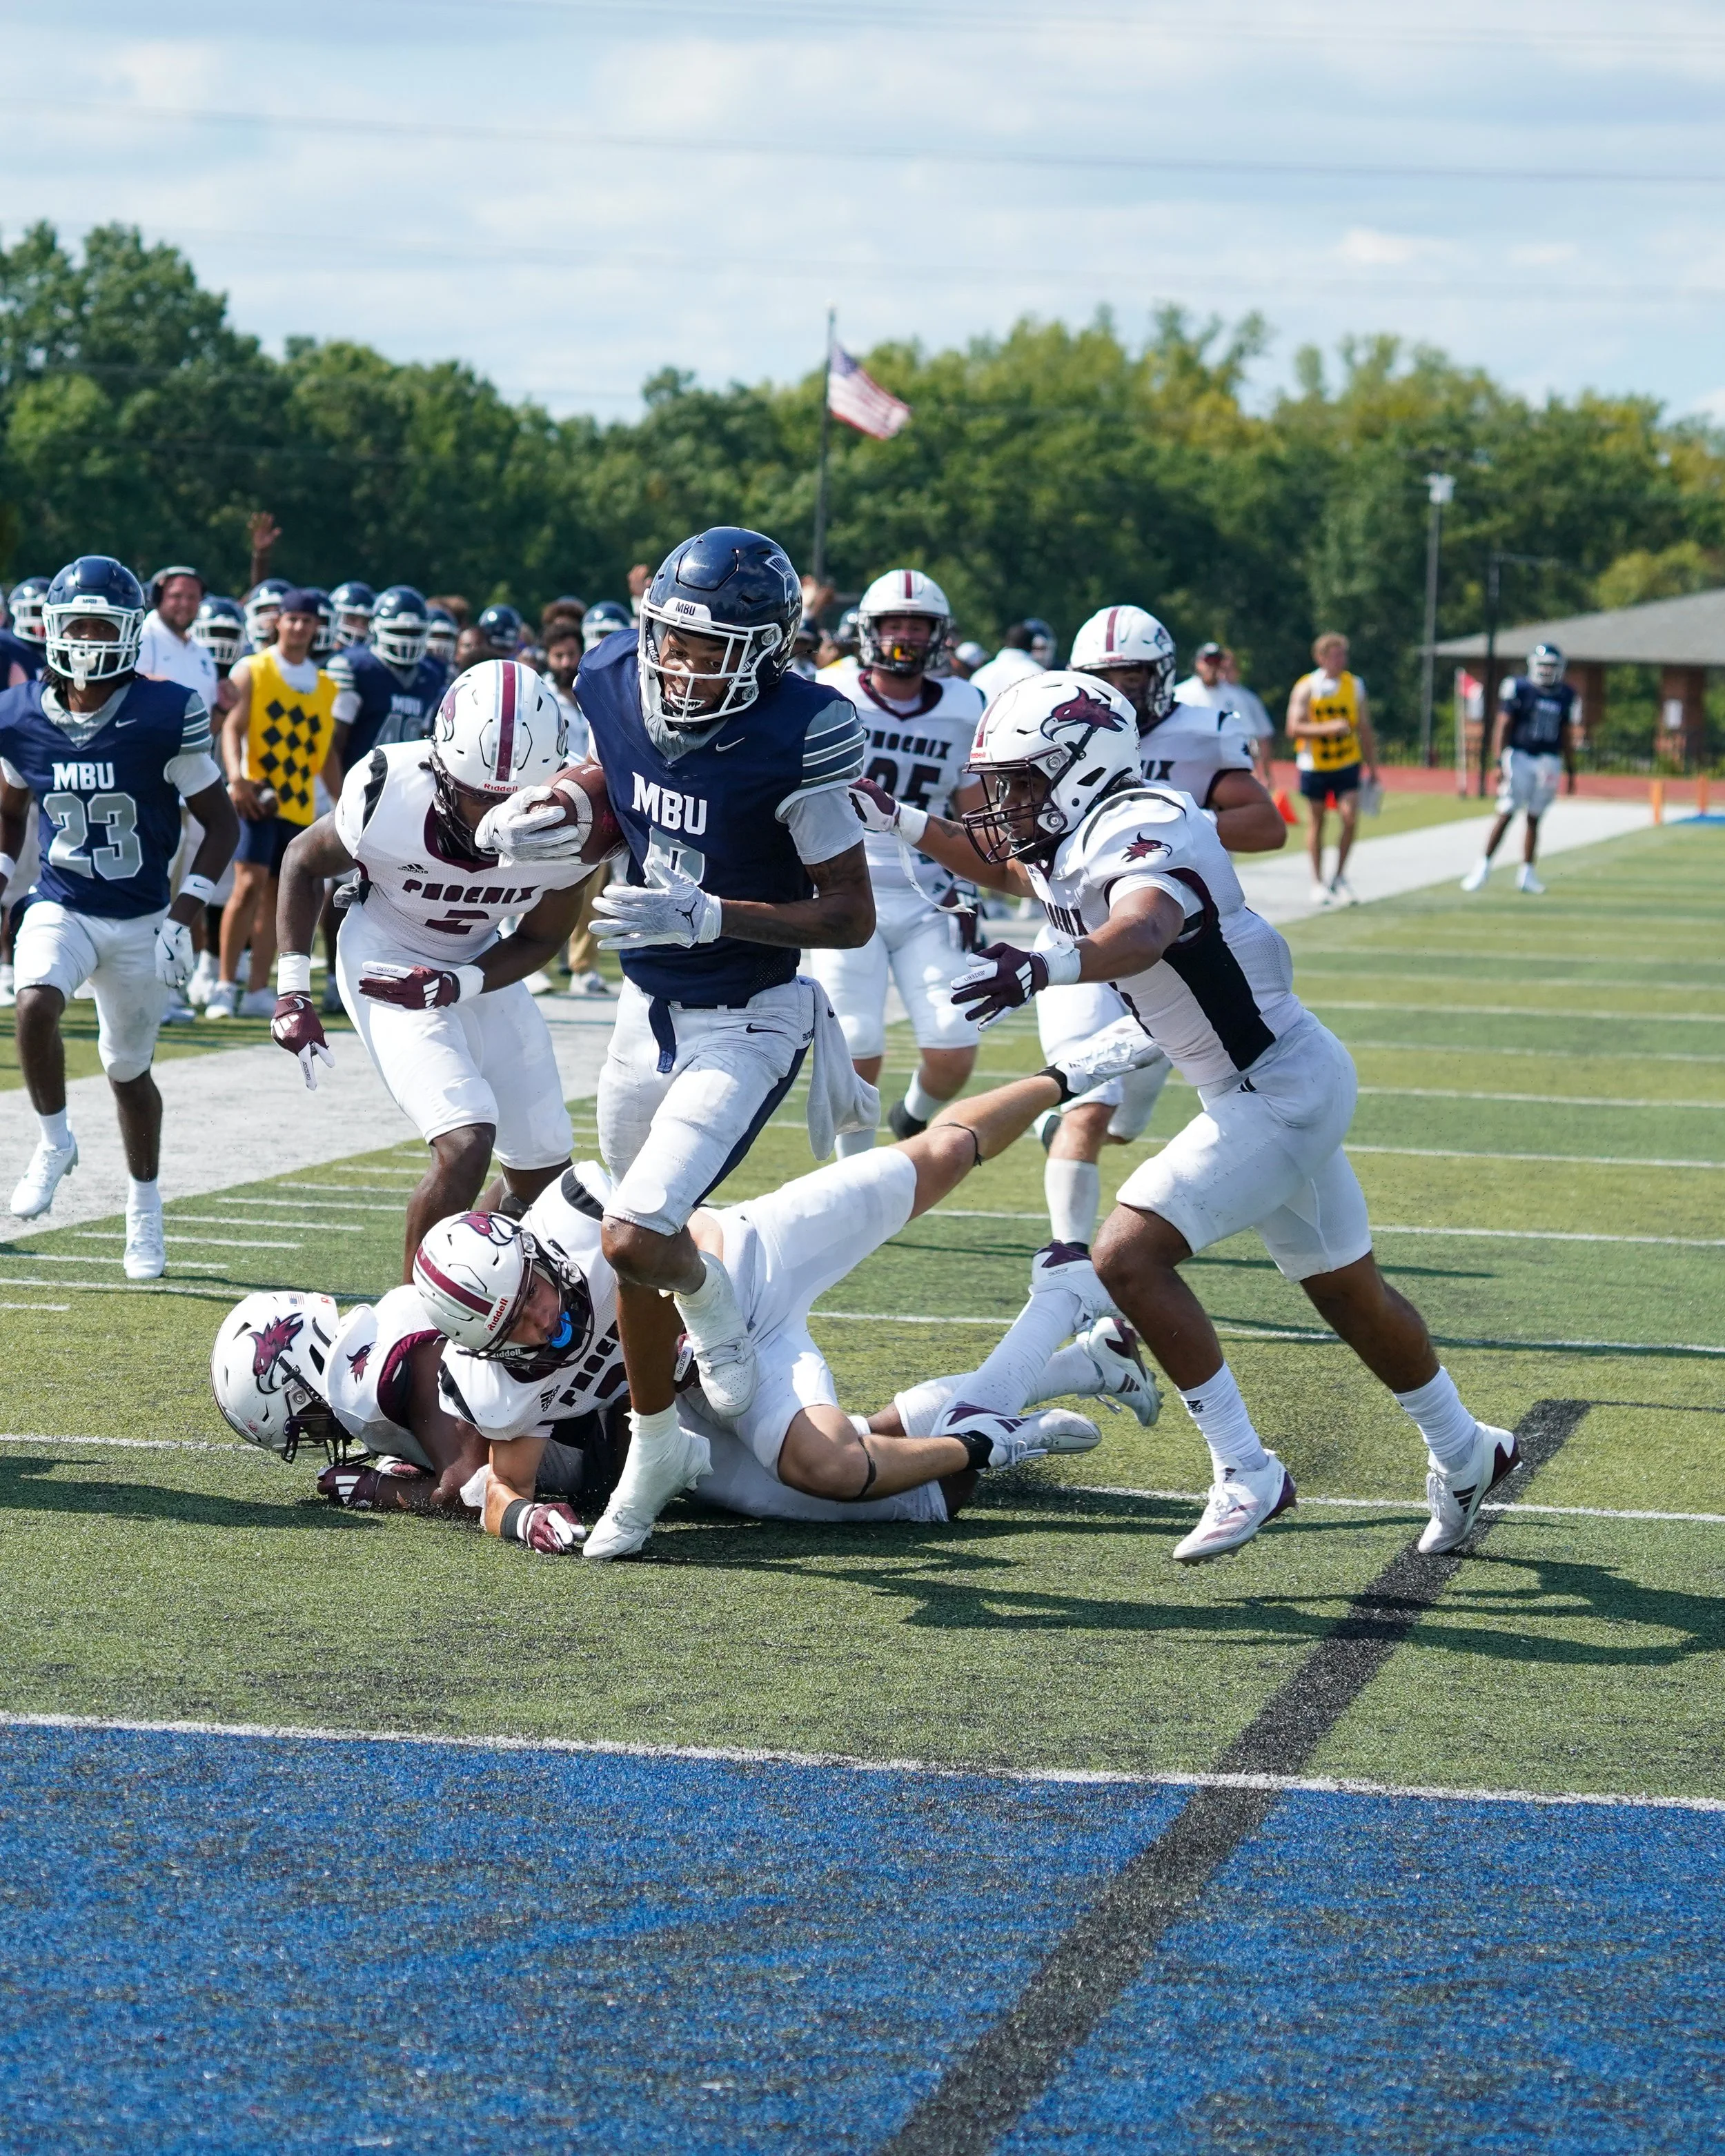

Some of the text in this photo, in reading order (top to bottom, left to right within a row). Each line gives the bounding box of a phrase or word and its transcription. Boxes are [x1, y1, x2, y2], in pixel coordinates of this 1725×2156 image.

[675, 602, 696, 616] MBU
[52, 762, 115, 791] MBU
[484, 783, 518, 792] Riddell
[631, 771, 707, 835] MBU
[43, 792, 144, 880] 23
[402, 879, 541, 904] PHOENIX
[424, 909, 489, 936] 2
[964, 970, 985, 982] ADIZERO
[302, 1060, 311, 1080] ADIZERO
[487, 1298, 509, 1331] Riddell
[676, 1350, 688, 1374] ADIZERO
[542, 1385, 561, 1412] adidas
